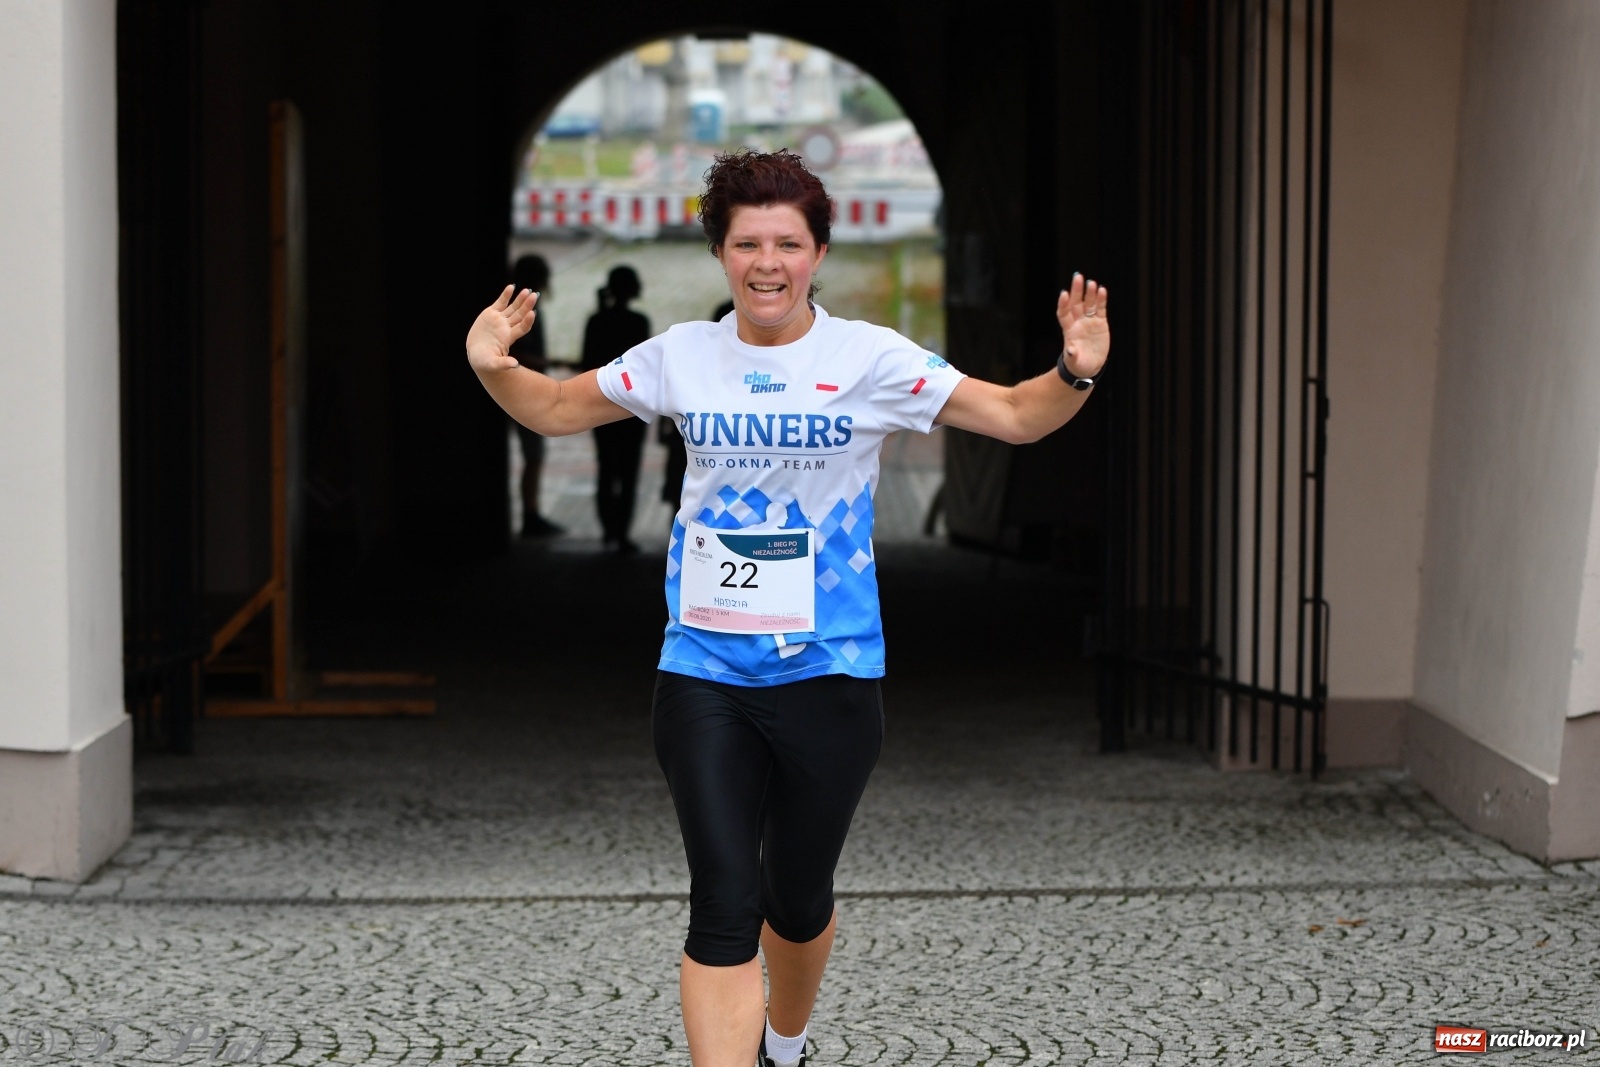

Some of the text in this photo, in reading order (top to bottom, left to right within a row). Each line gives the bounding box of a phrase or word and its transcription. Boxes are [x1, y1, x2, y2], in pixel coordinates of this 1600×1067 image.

[675, 412, 852, 448] RUNNERS
[695, 457, 826, 470] EKO-OKNA TEAM
[752, 548, 798, 556] NIEZALEŻNOŚĆ
[719, 561, 759, 589] 22
